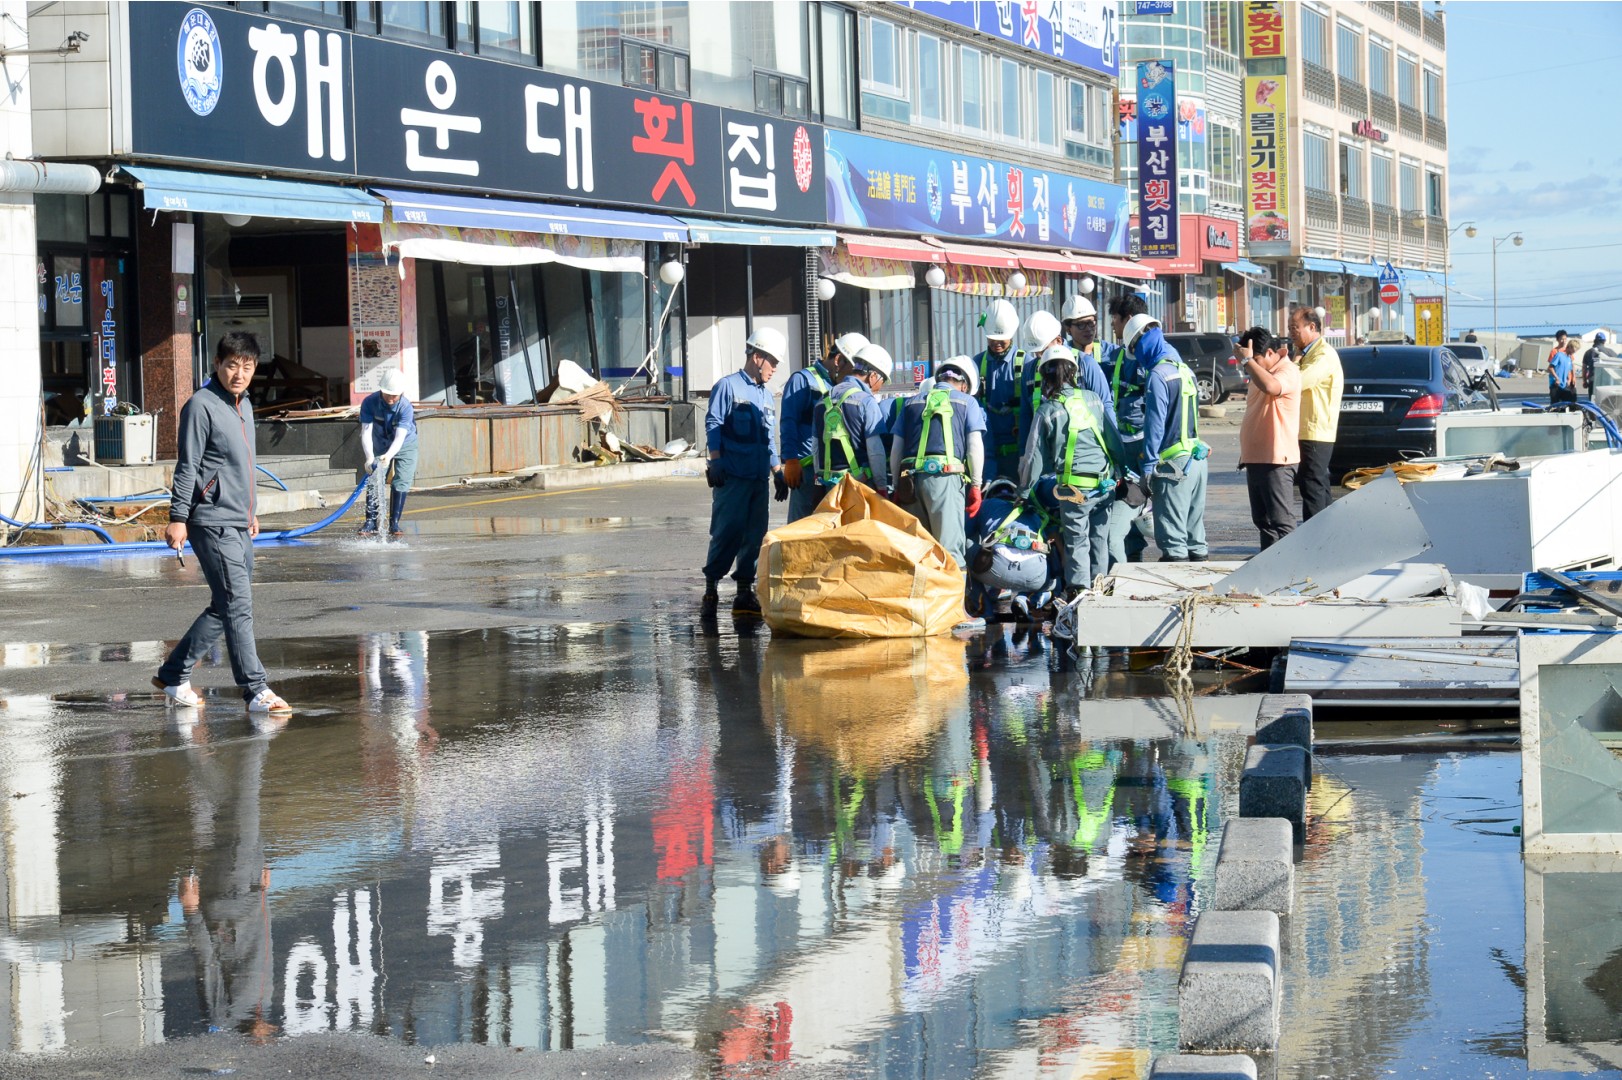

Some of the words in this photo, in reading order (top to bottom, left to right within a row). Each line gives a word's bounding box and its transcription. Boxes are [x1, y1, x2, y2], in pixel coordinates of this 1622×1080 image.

[1102, 6, 1114, 64] 2F
[182, 79, 202, 111] SINCE
[248, 23, 778, 212] 해운대횟집
[1144, 125, 1171, 241] 부산횟집
[1250, 112, 1277, 211] 물고기횟집
[949, 159, 1050, 242] 부산횟집
[1273, 229, 1289, 240] 2F
[1357, 401, 1379, 410] 5039
